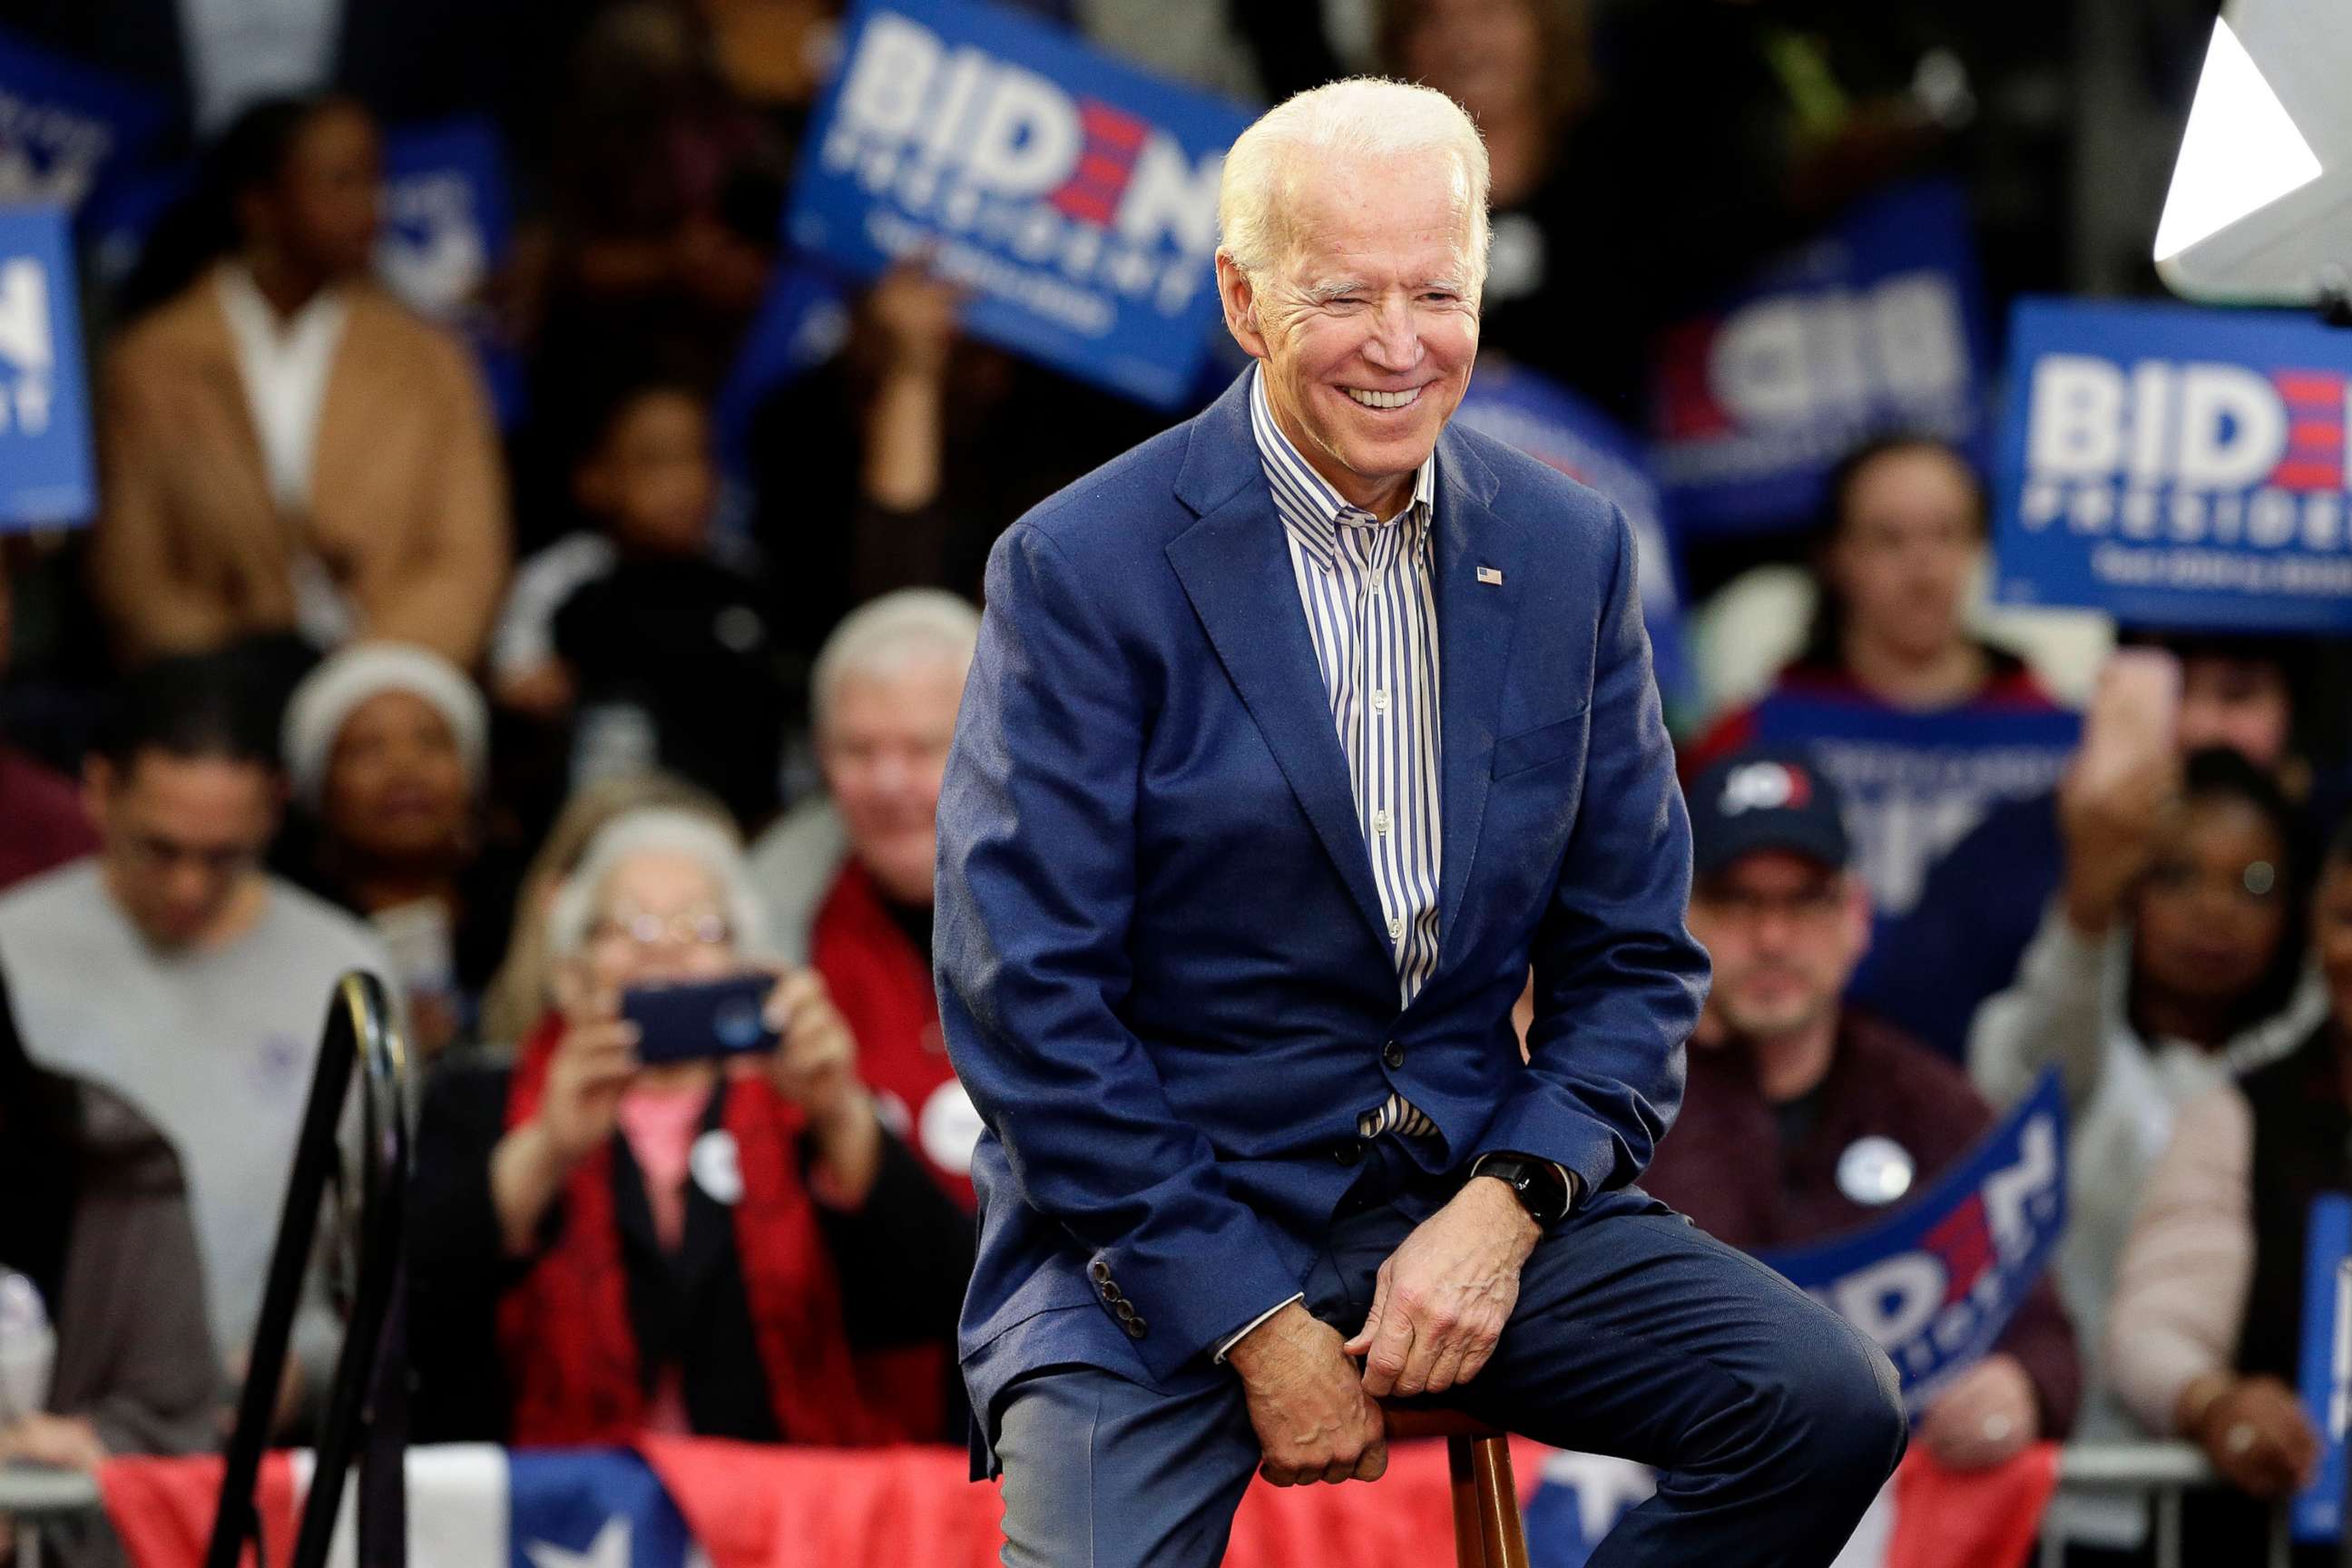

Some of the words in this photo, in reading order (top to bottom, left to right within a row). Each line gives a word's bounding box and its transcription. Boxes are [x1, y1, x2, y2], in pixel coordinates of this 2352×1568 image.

[2029, 354, 2352, 494] BIDE
[2020, 481, 2352, 552] PRESIDE
[1808, 1114, 2056, 1352] DEN
